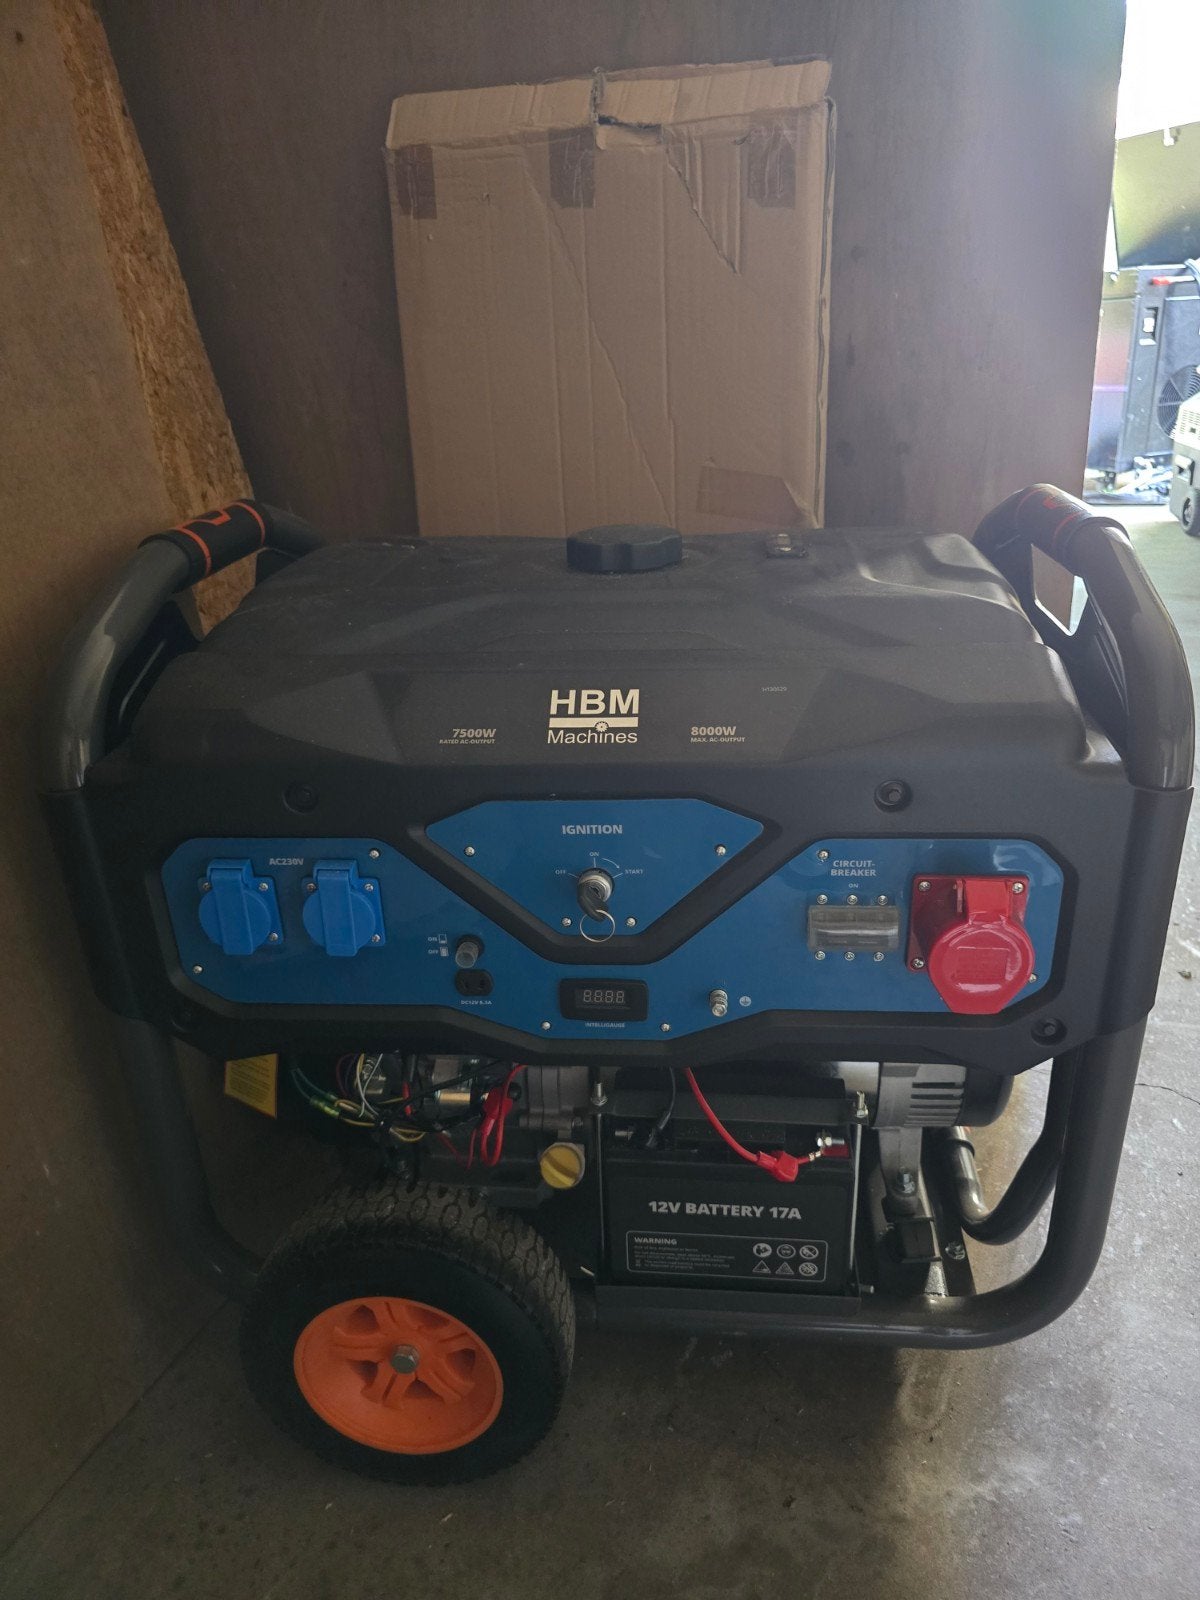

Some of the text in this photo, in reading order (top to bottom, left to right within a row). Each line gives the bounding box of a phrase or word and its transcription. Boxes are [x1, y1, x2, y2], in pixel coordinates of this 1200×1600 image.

[549, 688, 640, 715] HBM
[452, 728, 497, 738] 7500W
[690, 726, 737, 736] 8000W
[547, 729, 638, 744] Machines
[561, 824, 623, 835] IGNITION
[269, 857, 305, 866] AC230V
[832, 860, 876, 868] CIRCUIT-
[830, 869, 877, 877] BREAKER
[648, 1200, 803, 1220] 12V BATTERY 17A
[634, 1237, 678, 1245] WARNING
